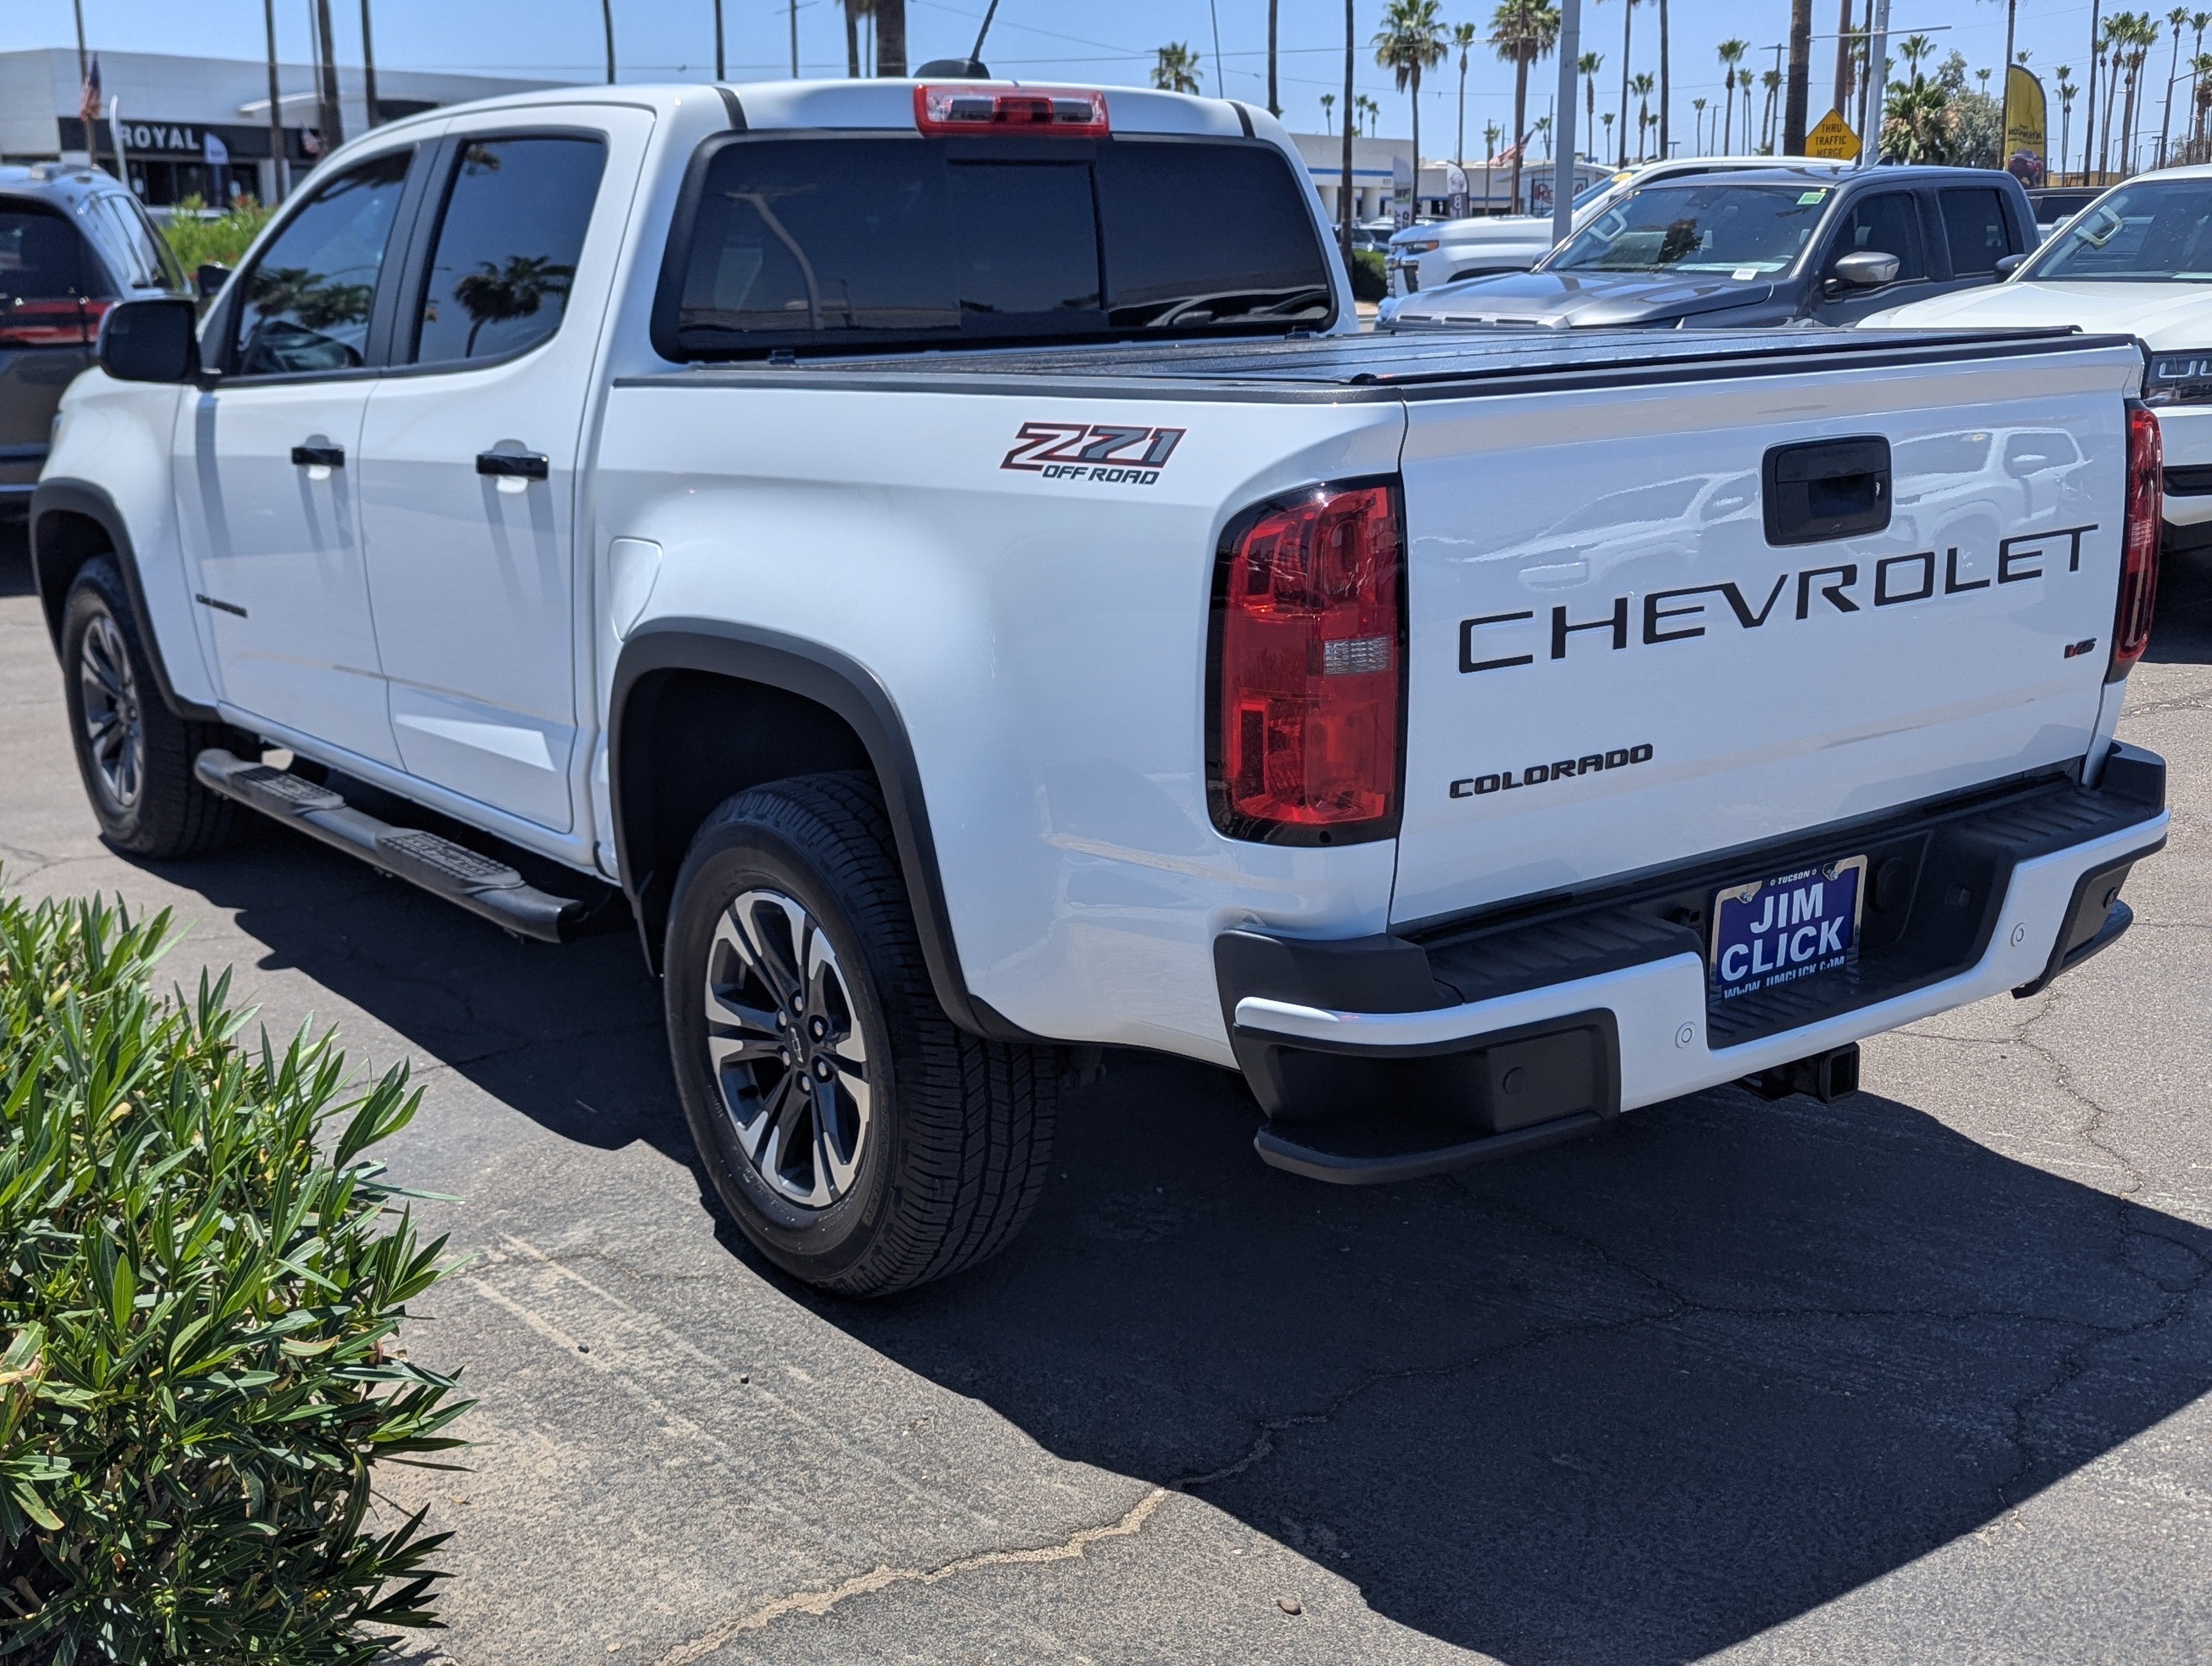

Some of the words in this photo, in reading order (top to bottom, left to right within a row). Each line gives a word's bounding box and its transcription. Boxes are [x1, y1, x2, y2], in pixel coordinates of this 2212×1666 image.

[119, 124, 201, 150] ROYAL
[1815, 135, 1847, 146] TRAFFIC
[1822, 123, 1842, 133] THRU
[1816, 147, 1843, 157] MERGE
[999, 421, 1187, 472] Z71
[1042, 464, 1089, 480] OFF
[1088, 467, 1160, 485] ROAD
[1457, 523, 2098, 674] CHEVROLET
[1449, 743, 1654, 799] COLORADO
[1778, 869, 1810, 885] TUCSON
[1750, 882, 1824, 933] JIM
[1721, 915, 1845, 981] CLICK
